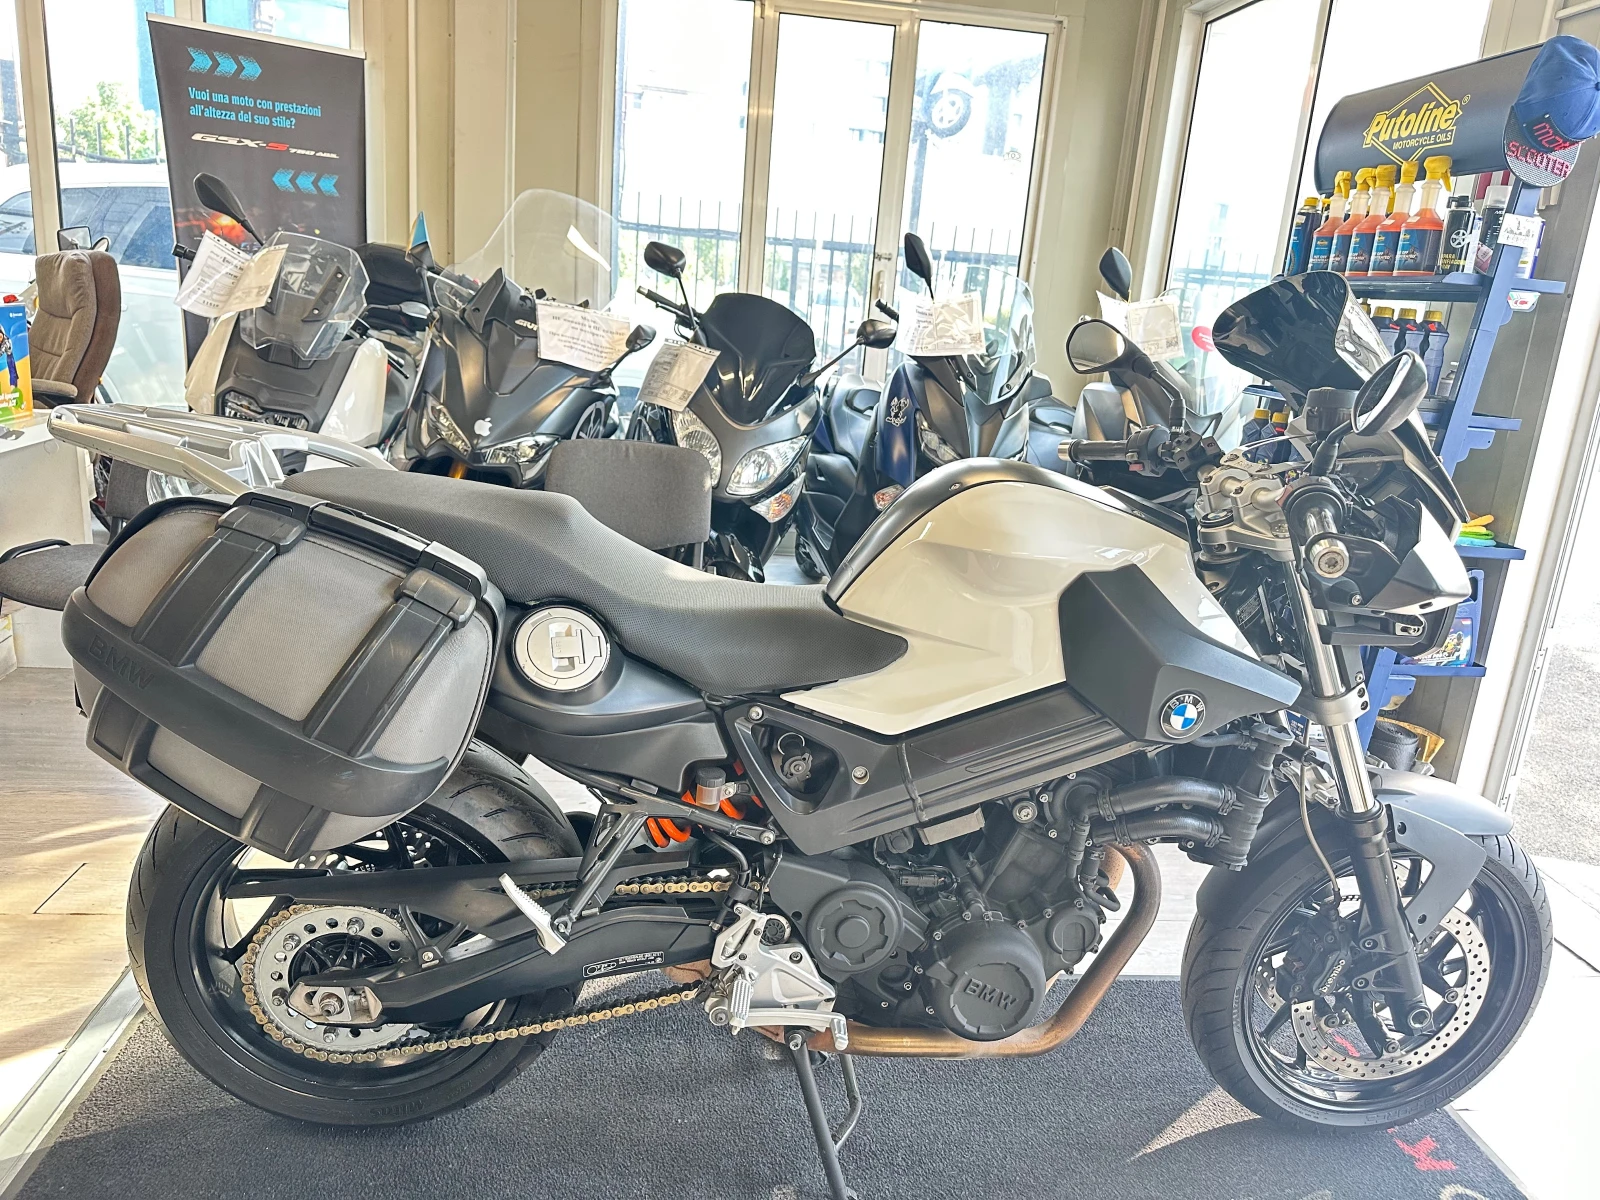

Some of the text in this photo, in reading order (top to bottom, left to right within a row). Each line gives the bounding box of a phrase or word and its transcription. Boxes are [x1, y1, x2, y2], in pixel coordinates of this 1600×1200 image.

[188, 87, 322, 118] Vuoi una moto con prestazioni
[189, 105, 296, 129] all'altezza del suo stile?
[1366, 100, 1460, 142] Putoline
[1392, 131, 1453, 151] MOTORCYCLE OILS
[1506, 140, 1572, 178] SCOOTER
[89, 634, 155, 690] BMW
[1319, 959, 1346, 993] brembo
[964, 977, 1018, 1011] BMW
